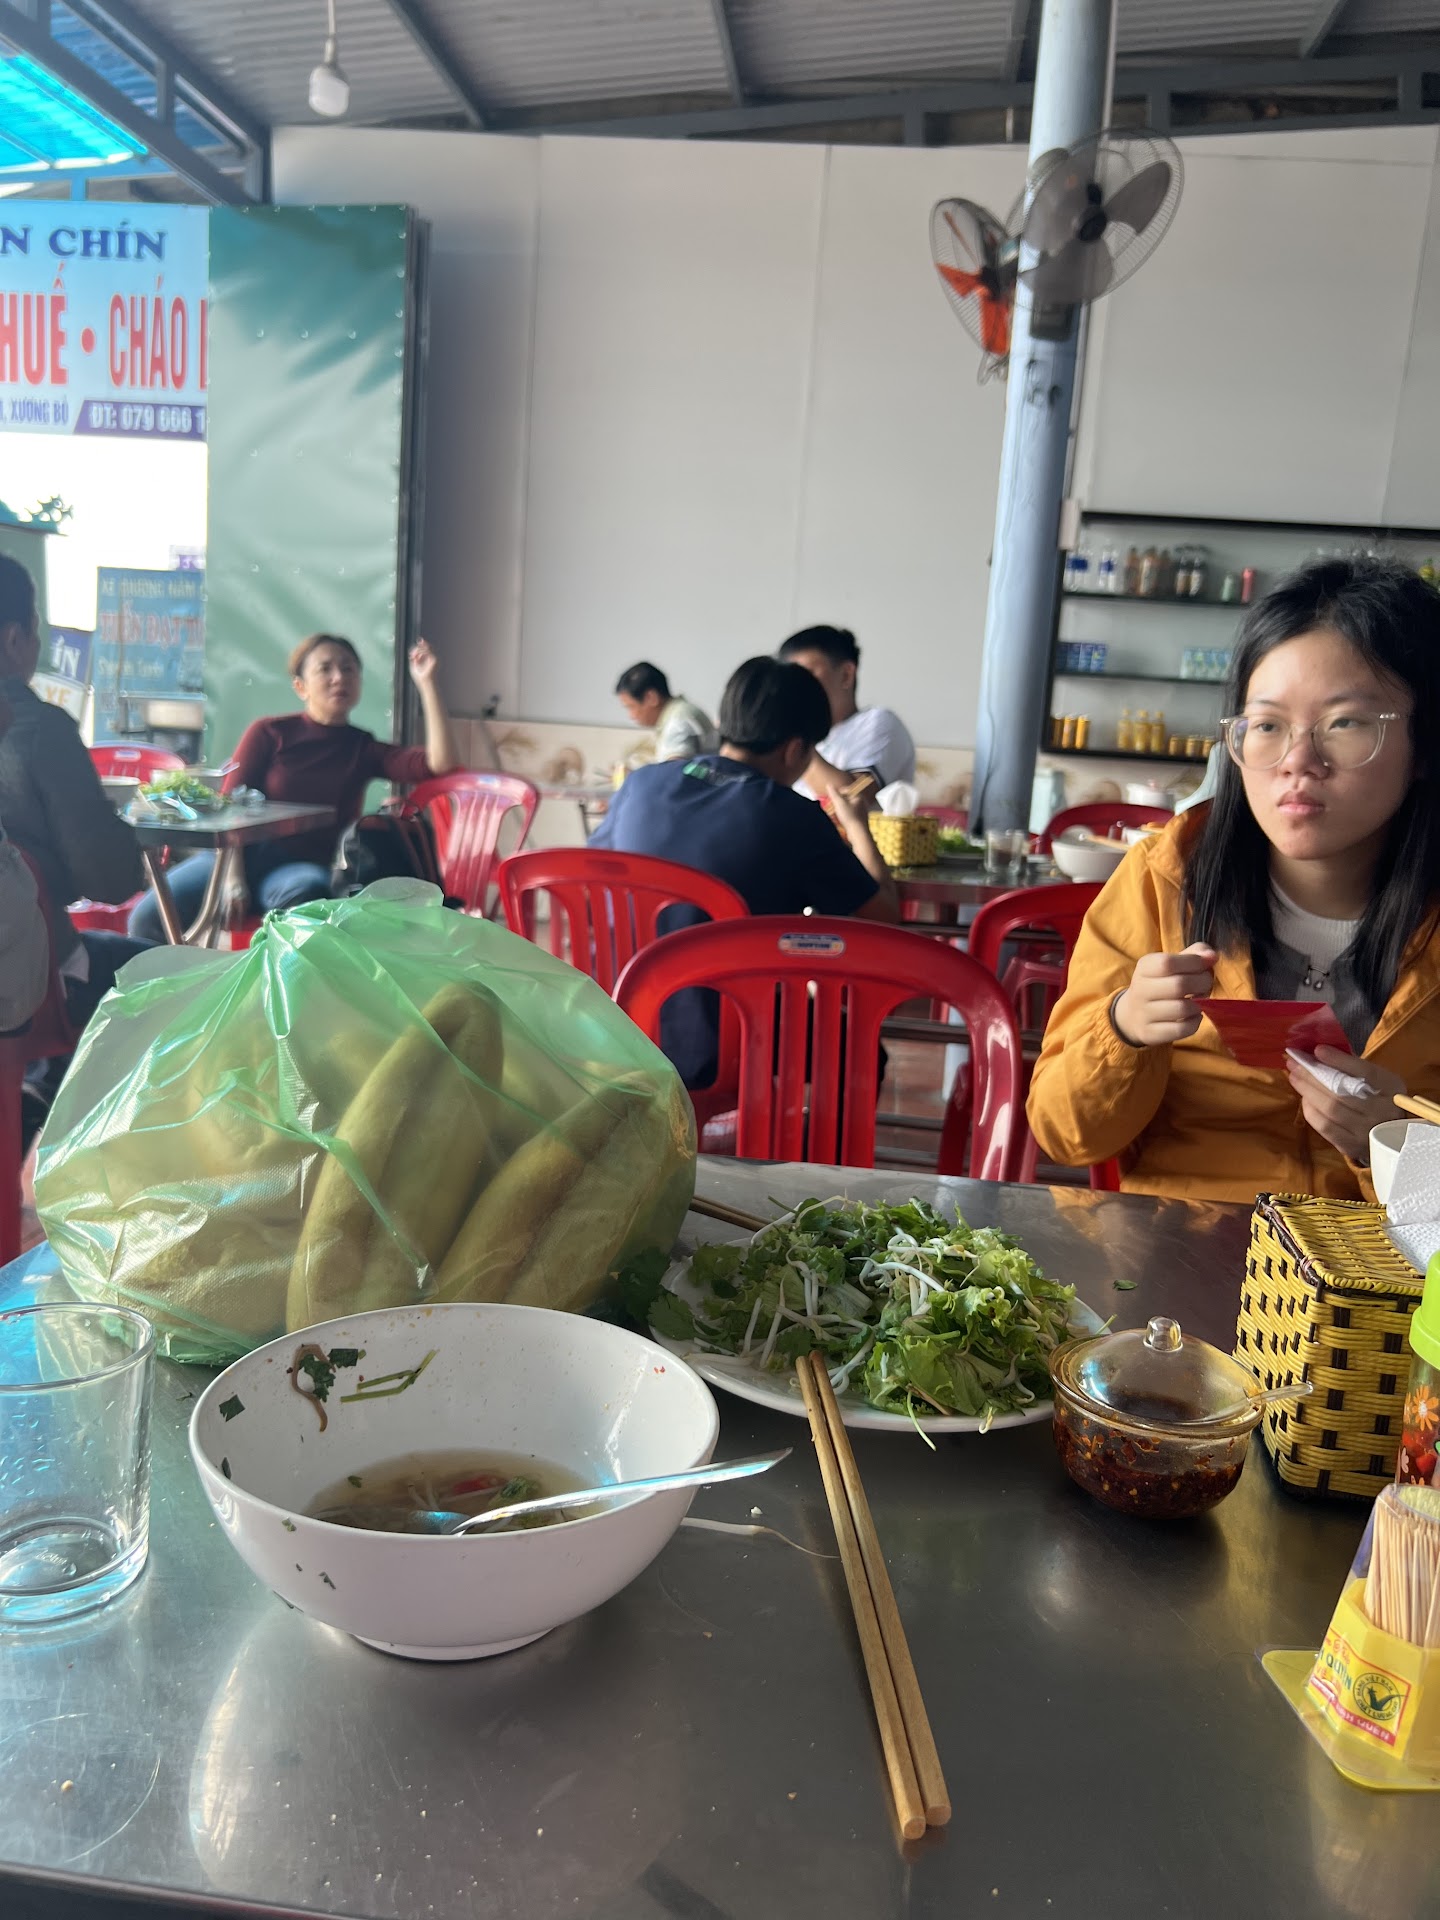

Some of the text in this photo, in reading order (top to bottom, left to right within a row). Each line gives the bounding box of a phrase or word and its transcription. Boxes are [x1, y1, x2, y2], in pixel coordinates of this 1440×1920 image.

[49, 220, 168, 260] CHÍN
[0, 261, 68, 385] HUẾ
[109, 274, 187, 389] CHÁO
[121, 403, 154, 431] 079
[157, 405, 191, 433] 666
